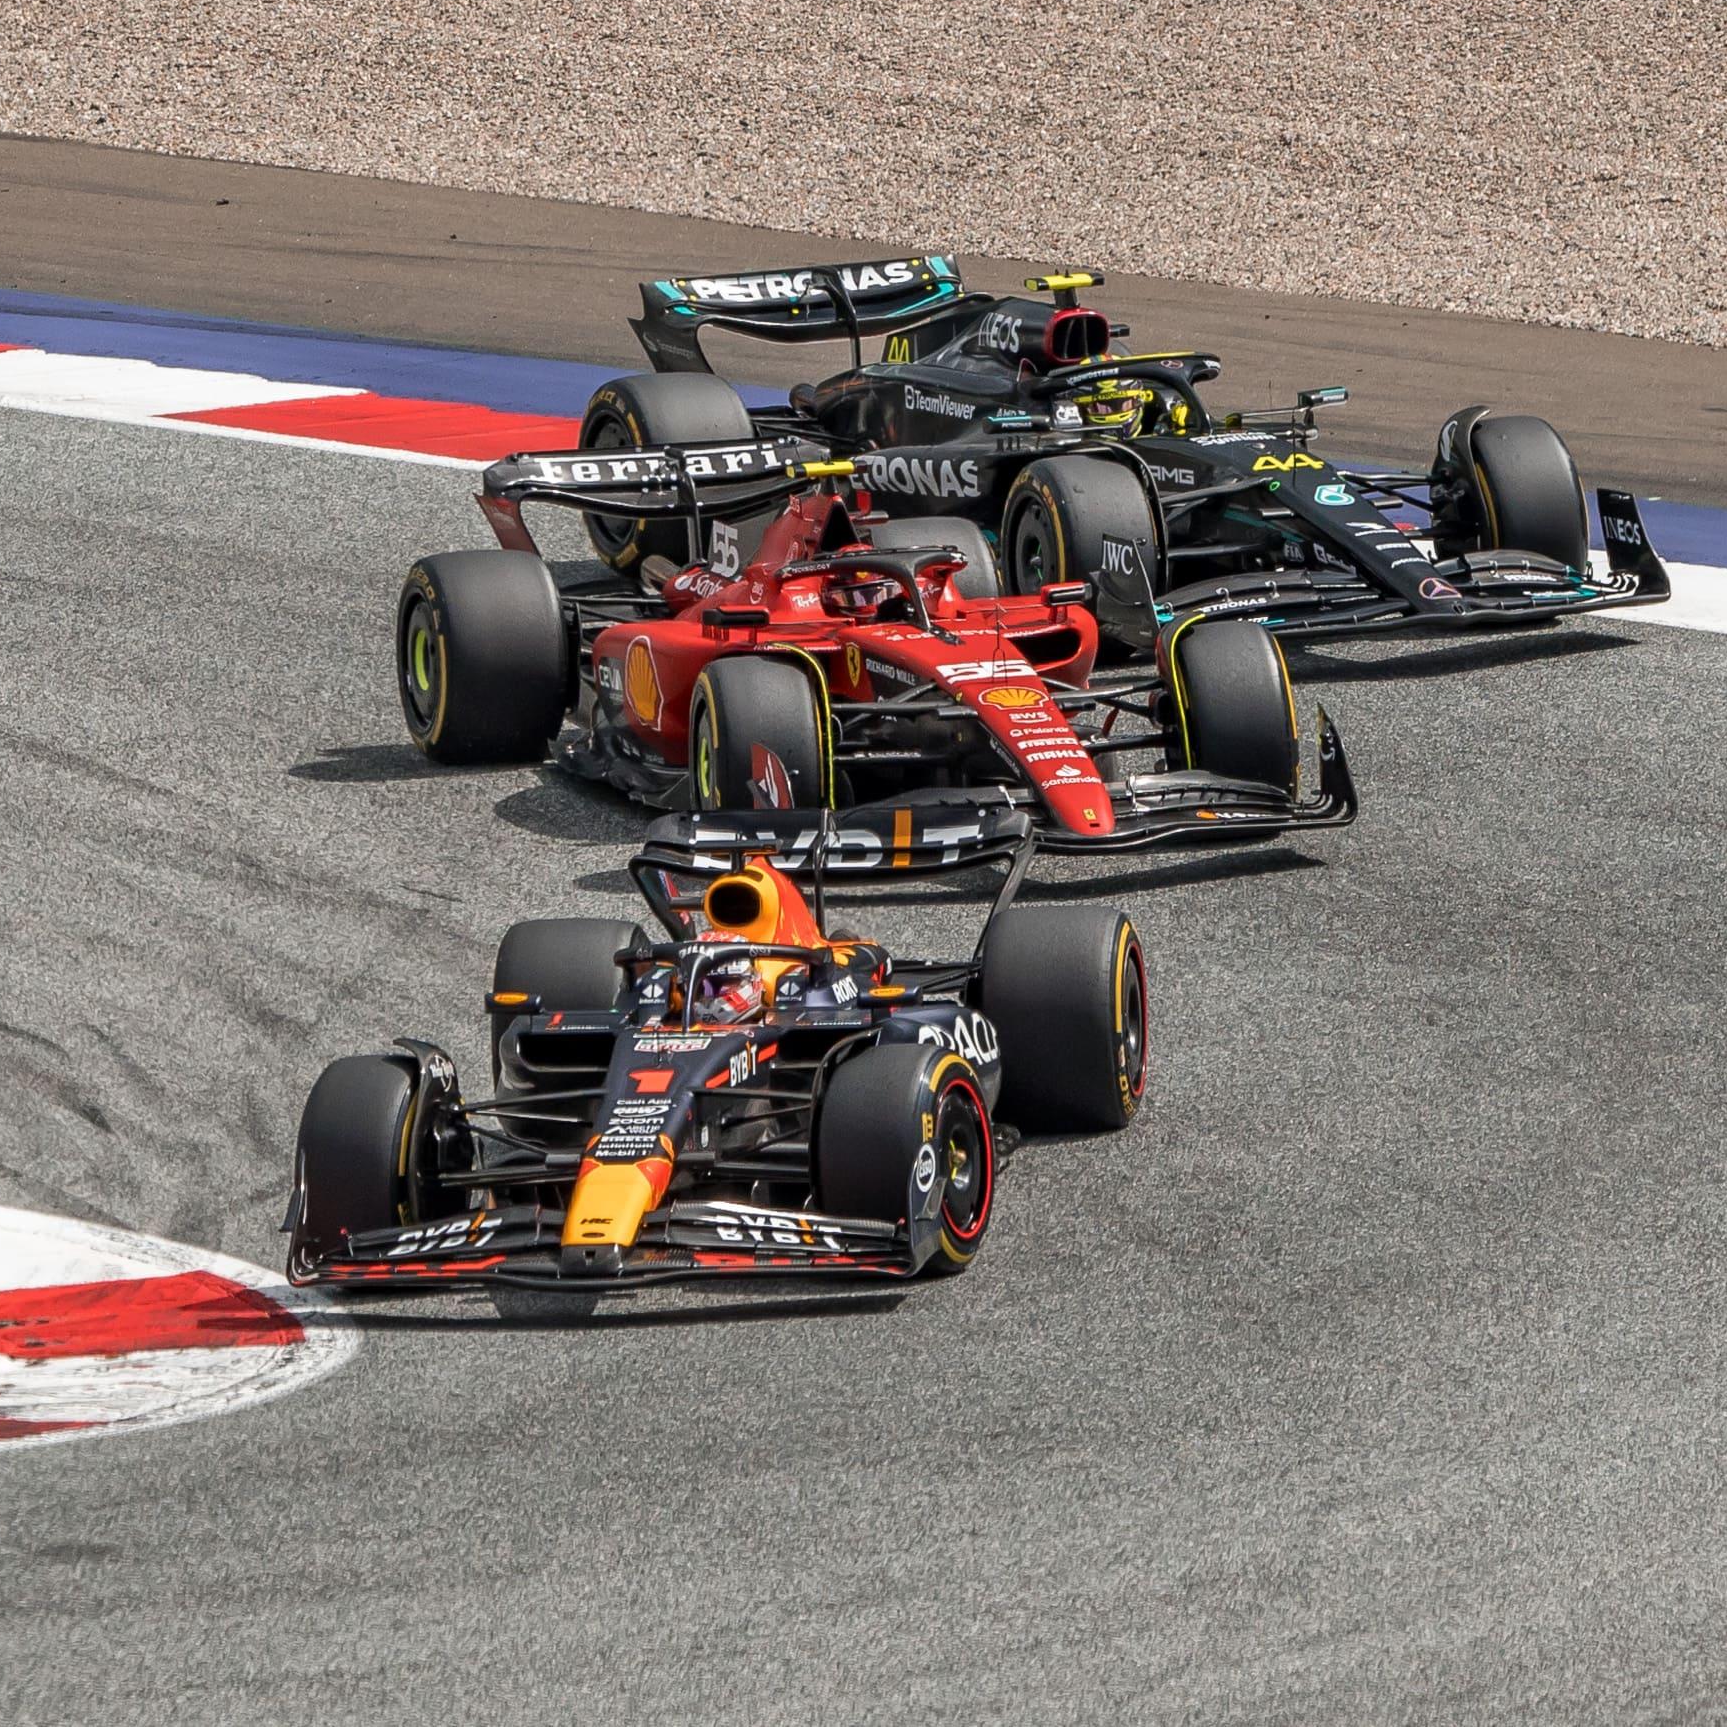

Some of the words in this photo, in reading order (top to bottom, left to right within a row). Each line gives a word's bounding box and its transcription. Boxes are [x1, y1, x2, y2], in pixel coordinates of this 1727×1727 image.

[978, 311, 1023, 354] INEOS
[887, 336, 911, 363] 44
[914, 388, 976, 420] TeamViewer
[529, 443, 785, 484] Ferrari
[1151, 465, 1195, 485] AMG
[1252, 453, 1324, 472] 44
[849, 456, 981, 498] ETRONAS
[1603, 515, 1642, 546] INEOS
[711, 519, 740, 578] 55
[1101, 539, 1134, 575] IWC
[865, 657, 896, 678] RICHARD
[936, 658, 1039, 685] 55
[1009, 712, 1049, 720] aws
[1026, 749, 1089, 763] MAHLE
[1041, 775, 1102, 790] Santander
[729, 1040, 758, 1088] BYBIT
[628, 1069, 675, 1093] 1
[608, 1117, 665, 1125] zoom
